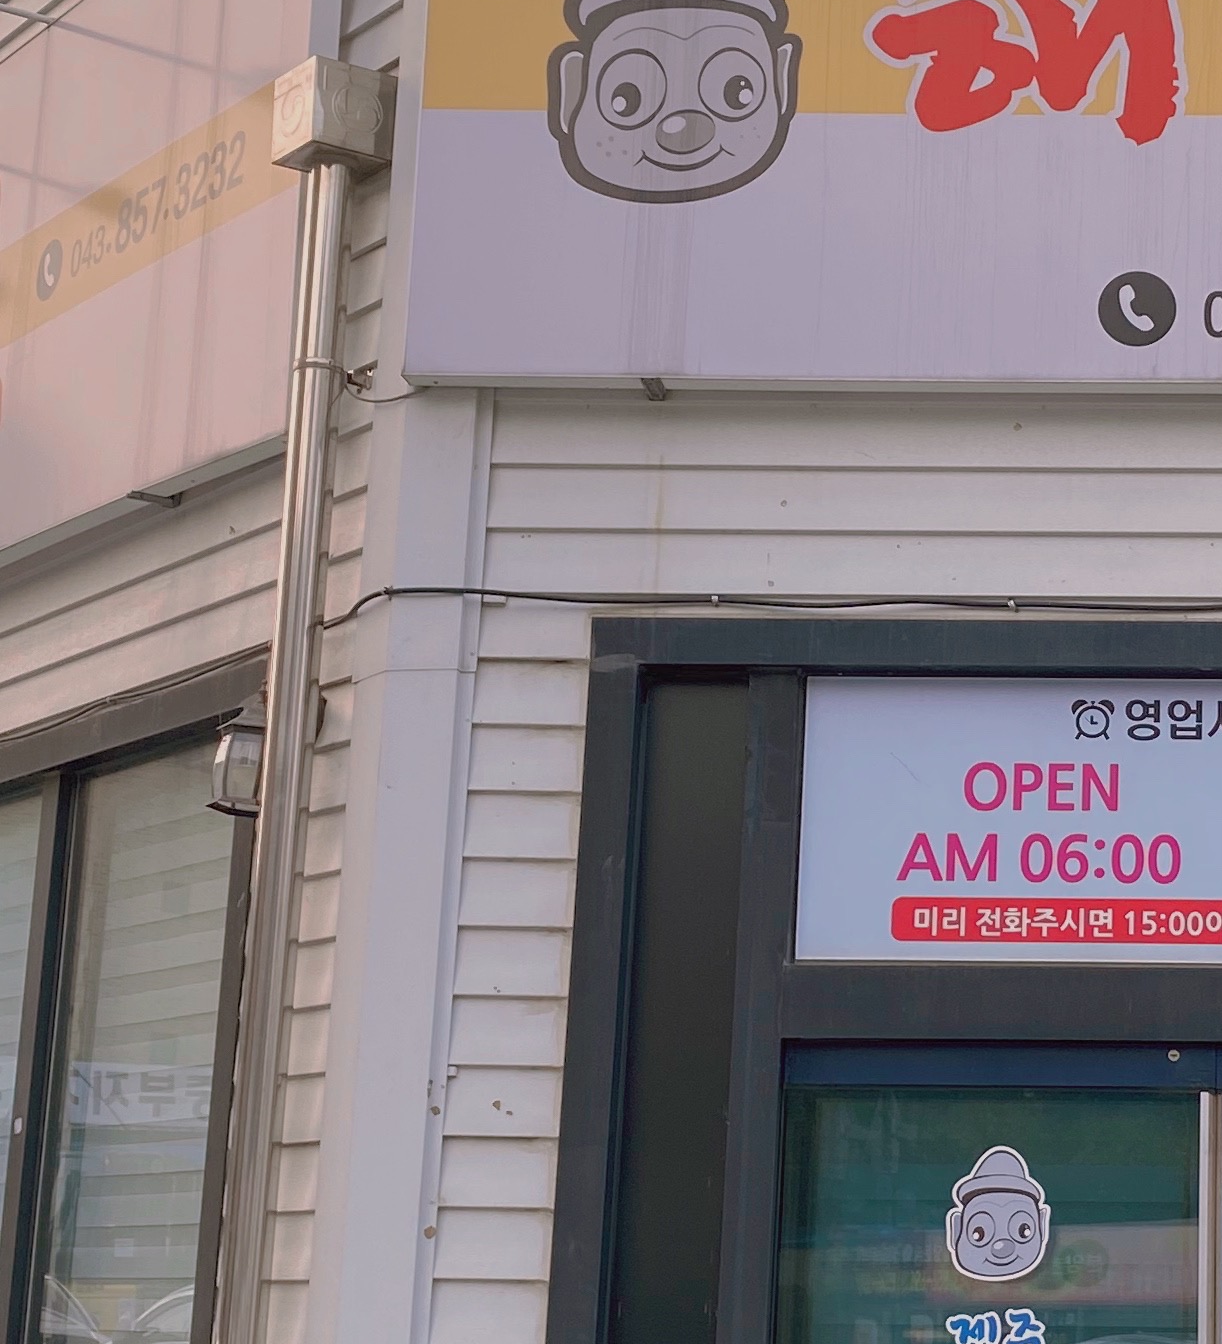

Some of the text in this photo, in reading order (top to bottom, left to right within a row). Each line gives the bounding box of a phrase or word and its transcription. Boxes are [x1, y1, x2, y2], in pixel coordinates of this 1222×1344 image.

[963, 761, 1120, 812] OPEN
[897, 833, 1182, 885] AM 06:00
[914, 906, 966, 936] 미리
[976, 907, 1113, 938] 전화주시면
